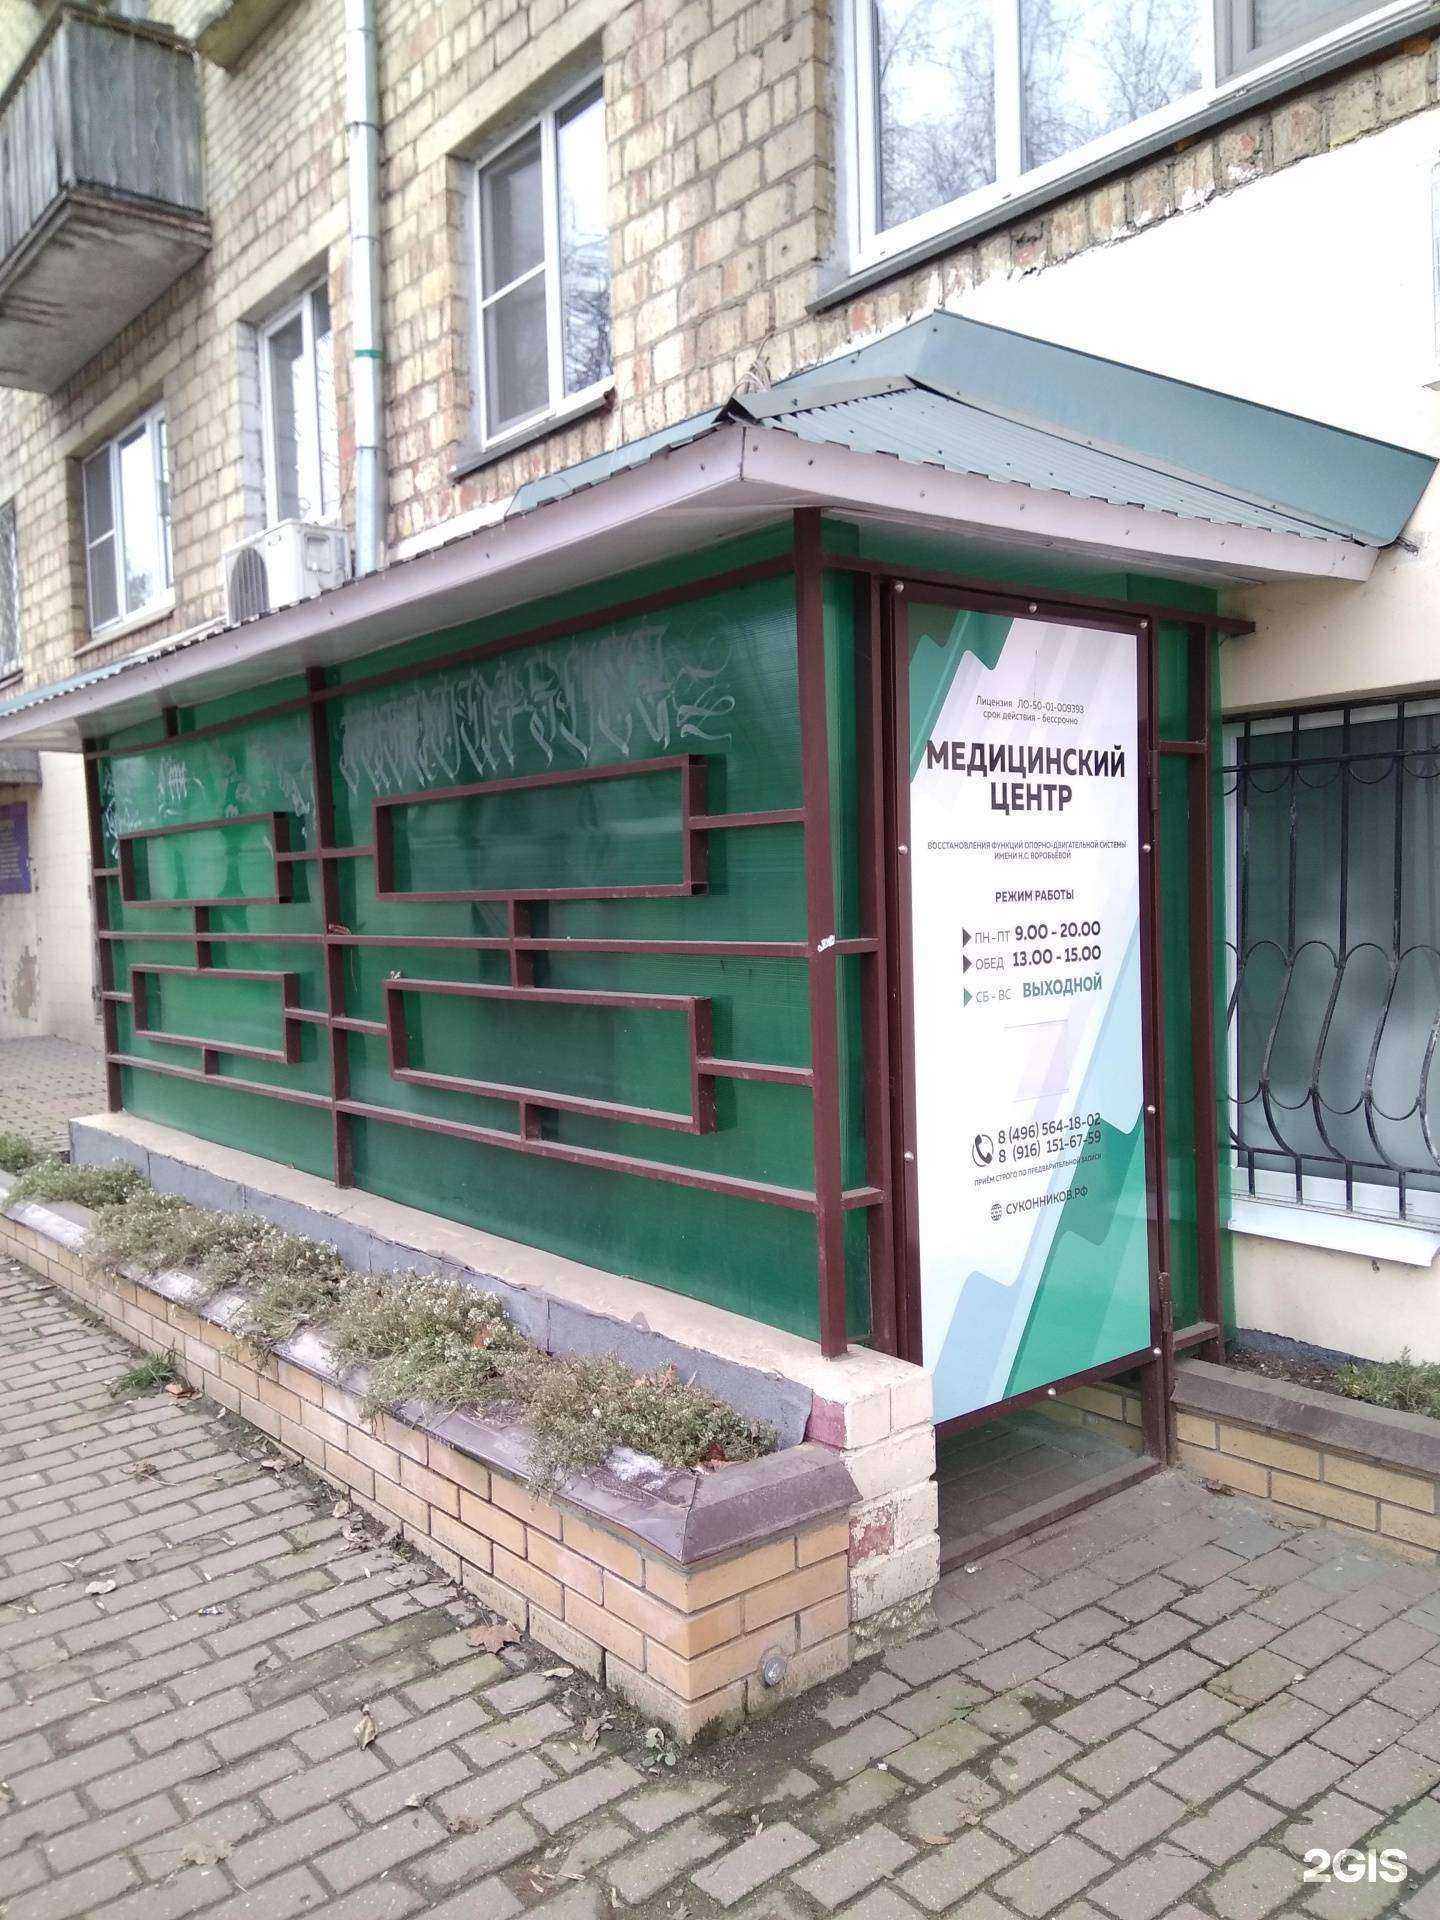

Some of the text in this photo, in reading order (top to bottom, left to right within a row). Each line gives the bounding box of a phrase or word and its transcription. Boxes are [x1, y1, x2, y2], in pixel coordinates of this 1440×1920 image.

[976, 695, 1012, 708] Лицензия
[983, 710, 1001, 720] срок
[1002, 711, 1036, 722] действия
[1042, 714, 1079, 726] бессрочно
[926, 740, 1125, 778] МЕДИЦИНСКИЙ
[990, 782, 1073, 816] ЦЕНТР
[927, 839, 1127, 850] ВОССТАНОВЛЕНИЯ ФУНКЦИЙ ОПОРНО-ДВИГАТЕЛЬНОЙ СИСТЕМЫ
[994, 852, 1018, 860] ИМЕНИ
[995, 889, 1074, 902] РЕЖИМ РАБОТЫ
[1015, 924, 1048, 941] 9.00
[1060, 921, 1101, 938] 20.00
[975, 957, 1005, 970] ОБЕД
[1013, 949, 1053, 967] 13.00
[1065, 945, 1101, 963] 15.00
[975, 991, 989, 1003] СБ
[998, 989, 1012, 1001] ВС
[1023, 972, 1102, 998] ВЫХОДНОЙ
[998, 1112, 1101, 1144] 8 (496) 564-18-02
[998, 1130, 1101, 1163] 8 (916) 151-67-59
[974, 1175, 995, 1187] ПРИЁМ
[995, 1170, 1018, 1182] СТРОГО
[1018, 1169, 1027, 1177] ПО
[1006, 1185, 1088, 1215] СУКОННИКОВ.РФ
